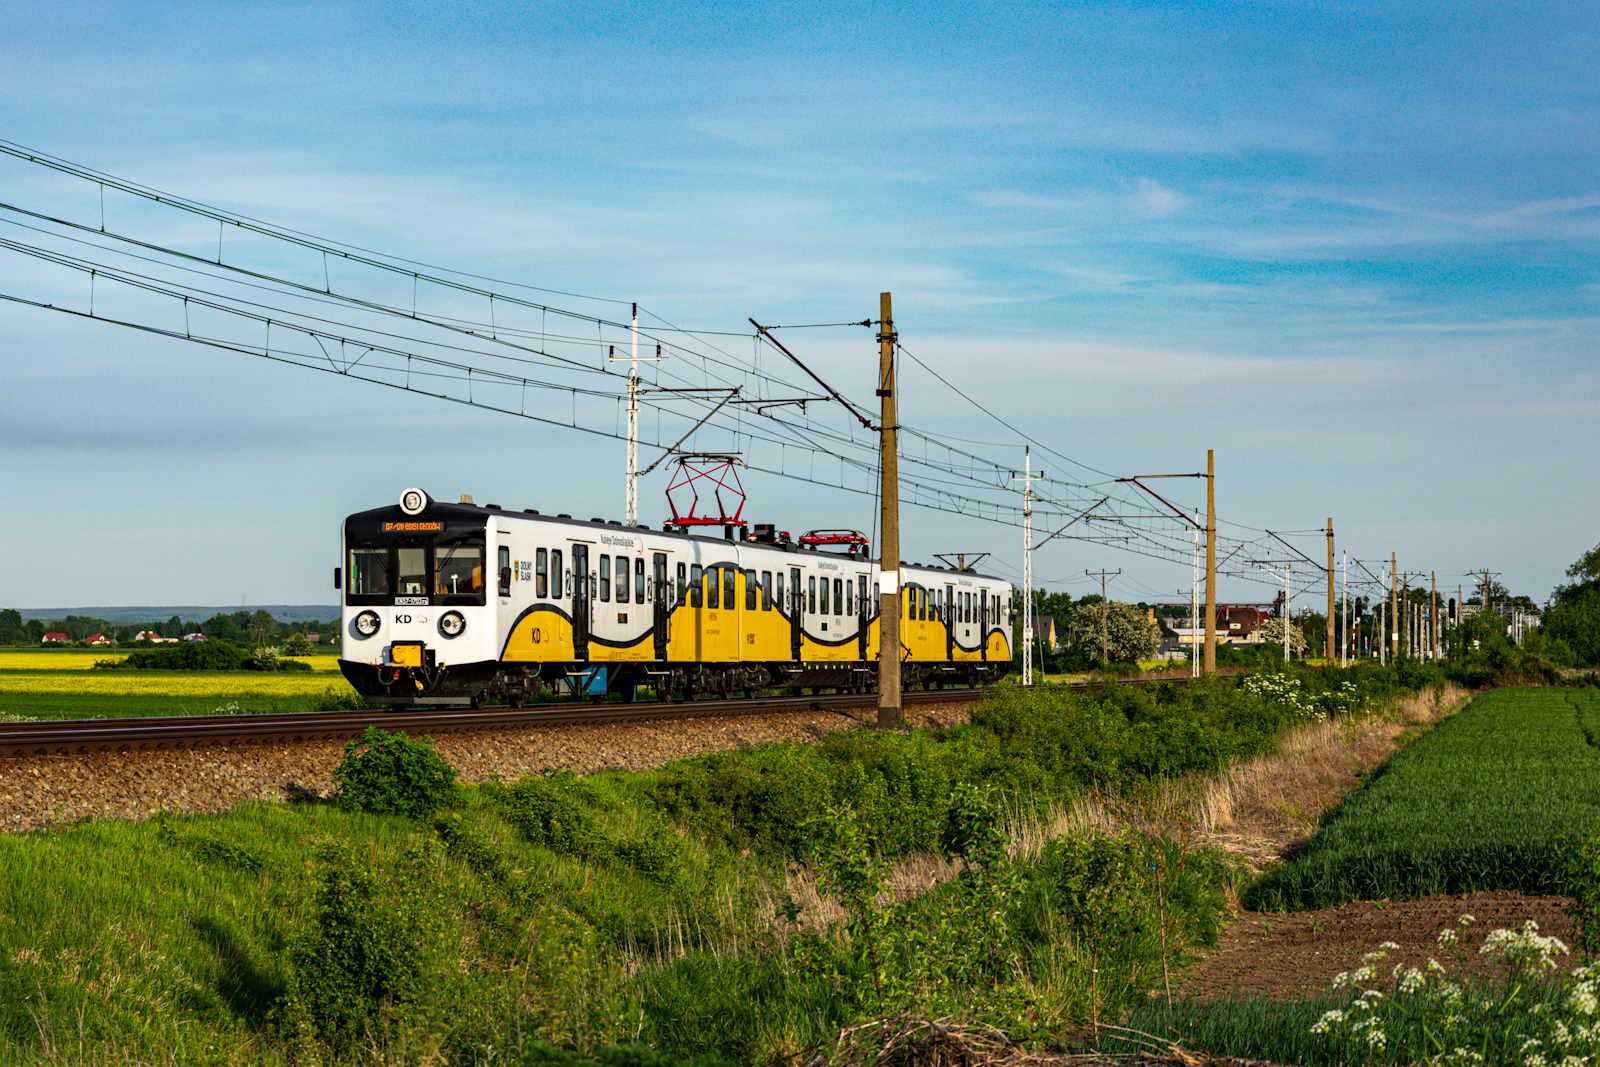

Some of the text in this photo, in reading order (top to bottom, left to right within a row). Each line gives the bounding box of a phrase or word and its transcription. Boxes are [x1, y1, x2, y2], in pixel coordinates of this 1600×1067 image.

[566, 573, 571, 595] 2
[647, 579, 652, 600] 2
[395, 614, 412, 624] KD
[531, 627, 541, 644] KD
